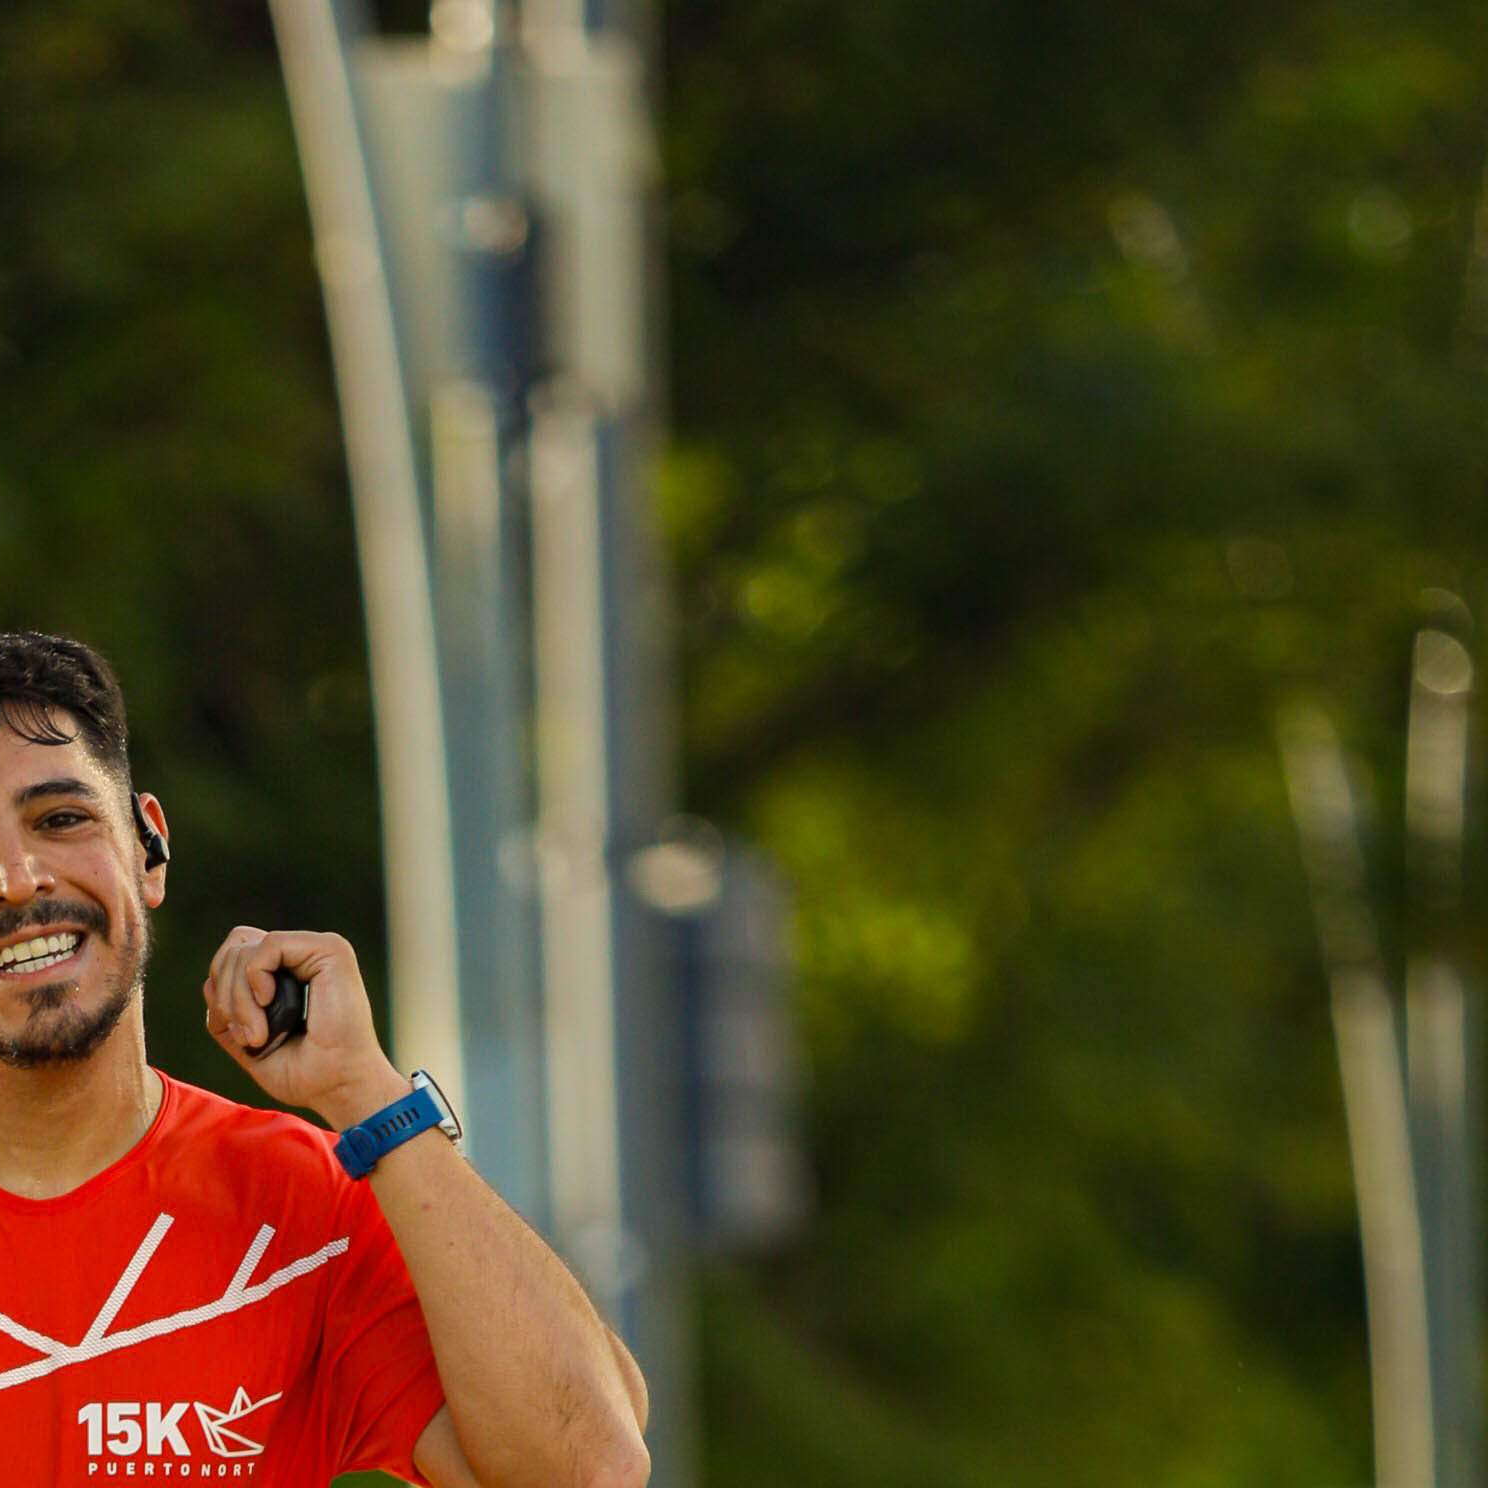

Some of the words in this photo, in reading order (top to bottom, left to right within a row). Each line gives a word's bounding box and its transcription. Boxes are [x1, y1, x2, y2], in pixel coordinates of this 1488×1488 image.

[77, 1402, 192, 1456] 15K
[88, 1462, 191, 1476] PUERTO
[201, 1462, 255, 1477] NORT
